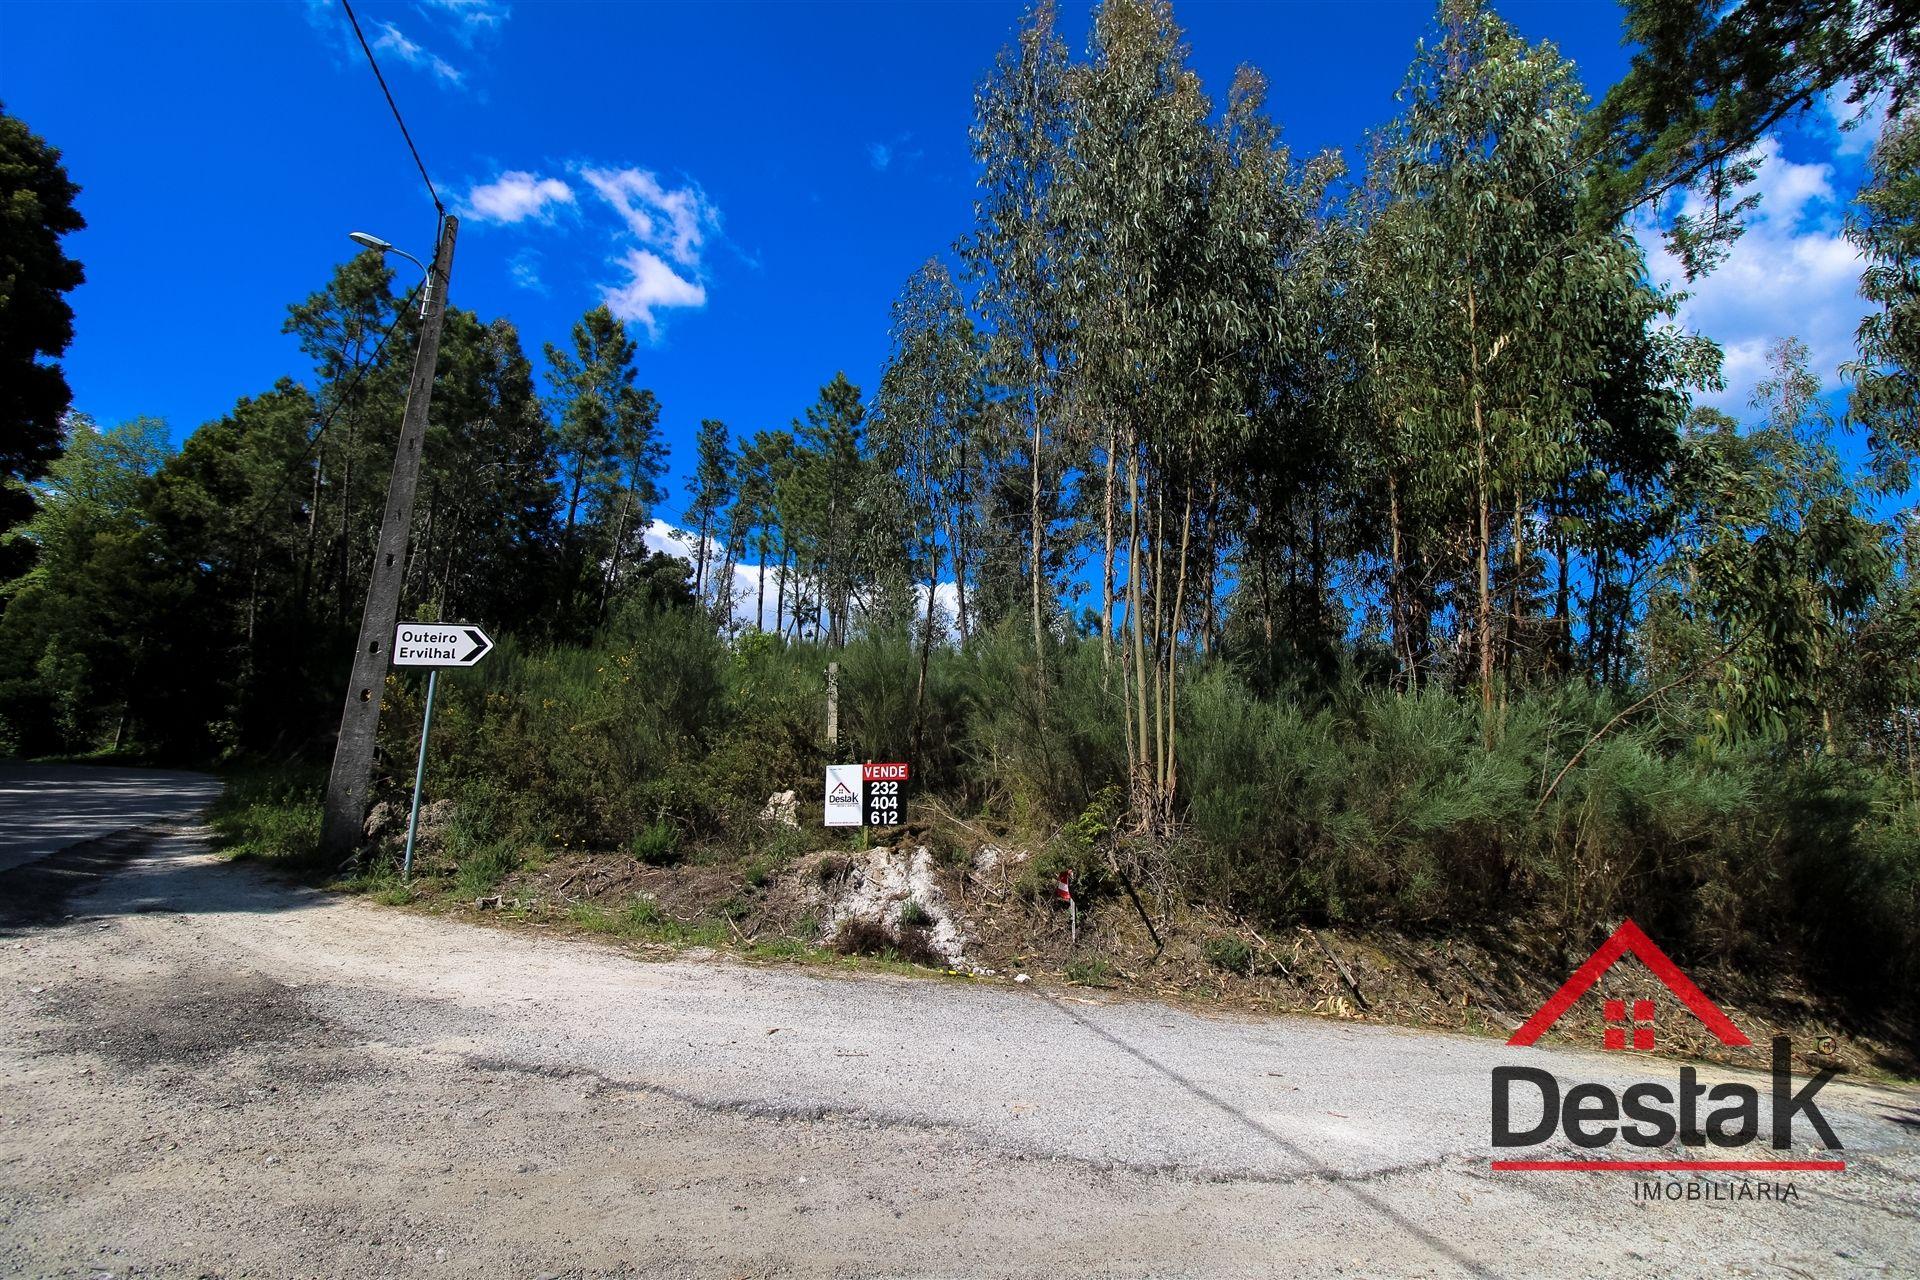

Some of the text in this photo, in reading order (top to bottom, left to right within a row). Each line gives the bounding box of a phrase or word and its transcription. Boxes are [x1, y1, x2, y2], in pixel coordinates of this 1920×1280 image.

[402, 631, 457, 643] Outeiro
[400, 647, 456, 659] Ervilhal
[864, 766, 906, 778] VENDE
[870, 781, 898, 795] 232
[870, 796, 898, 810] 404
[870, 811, 898, 825] 612
